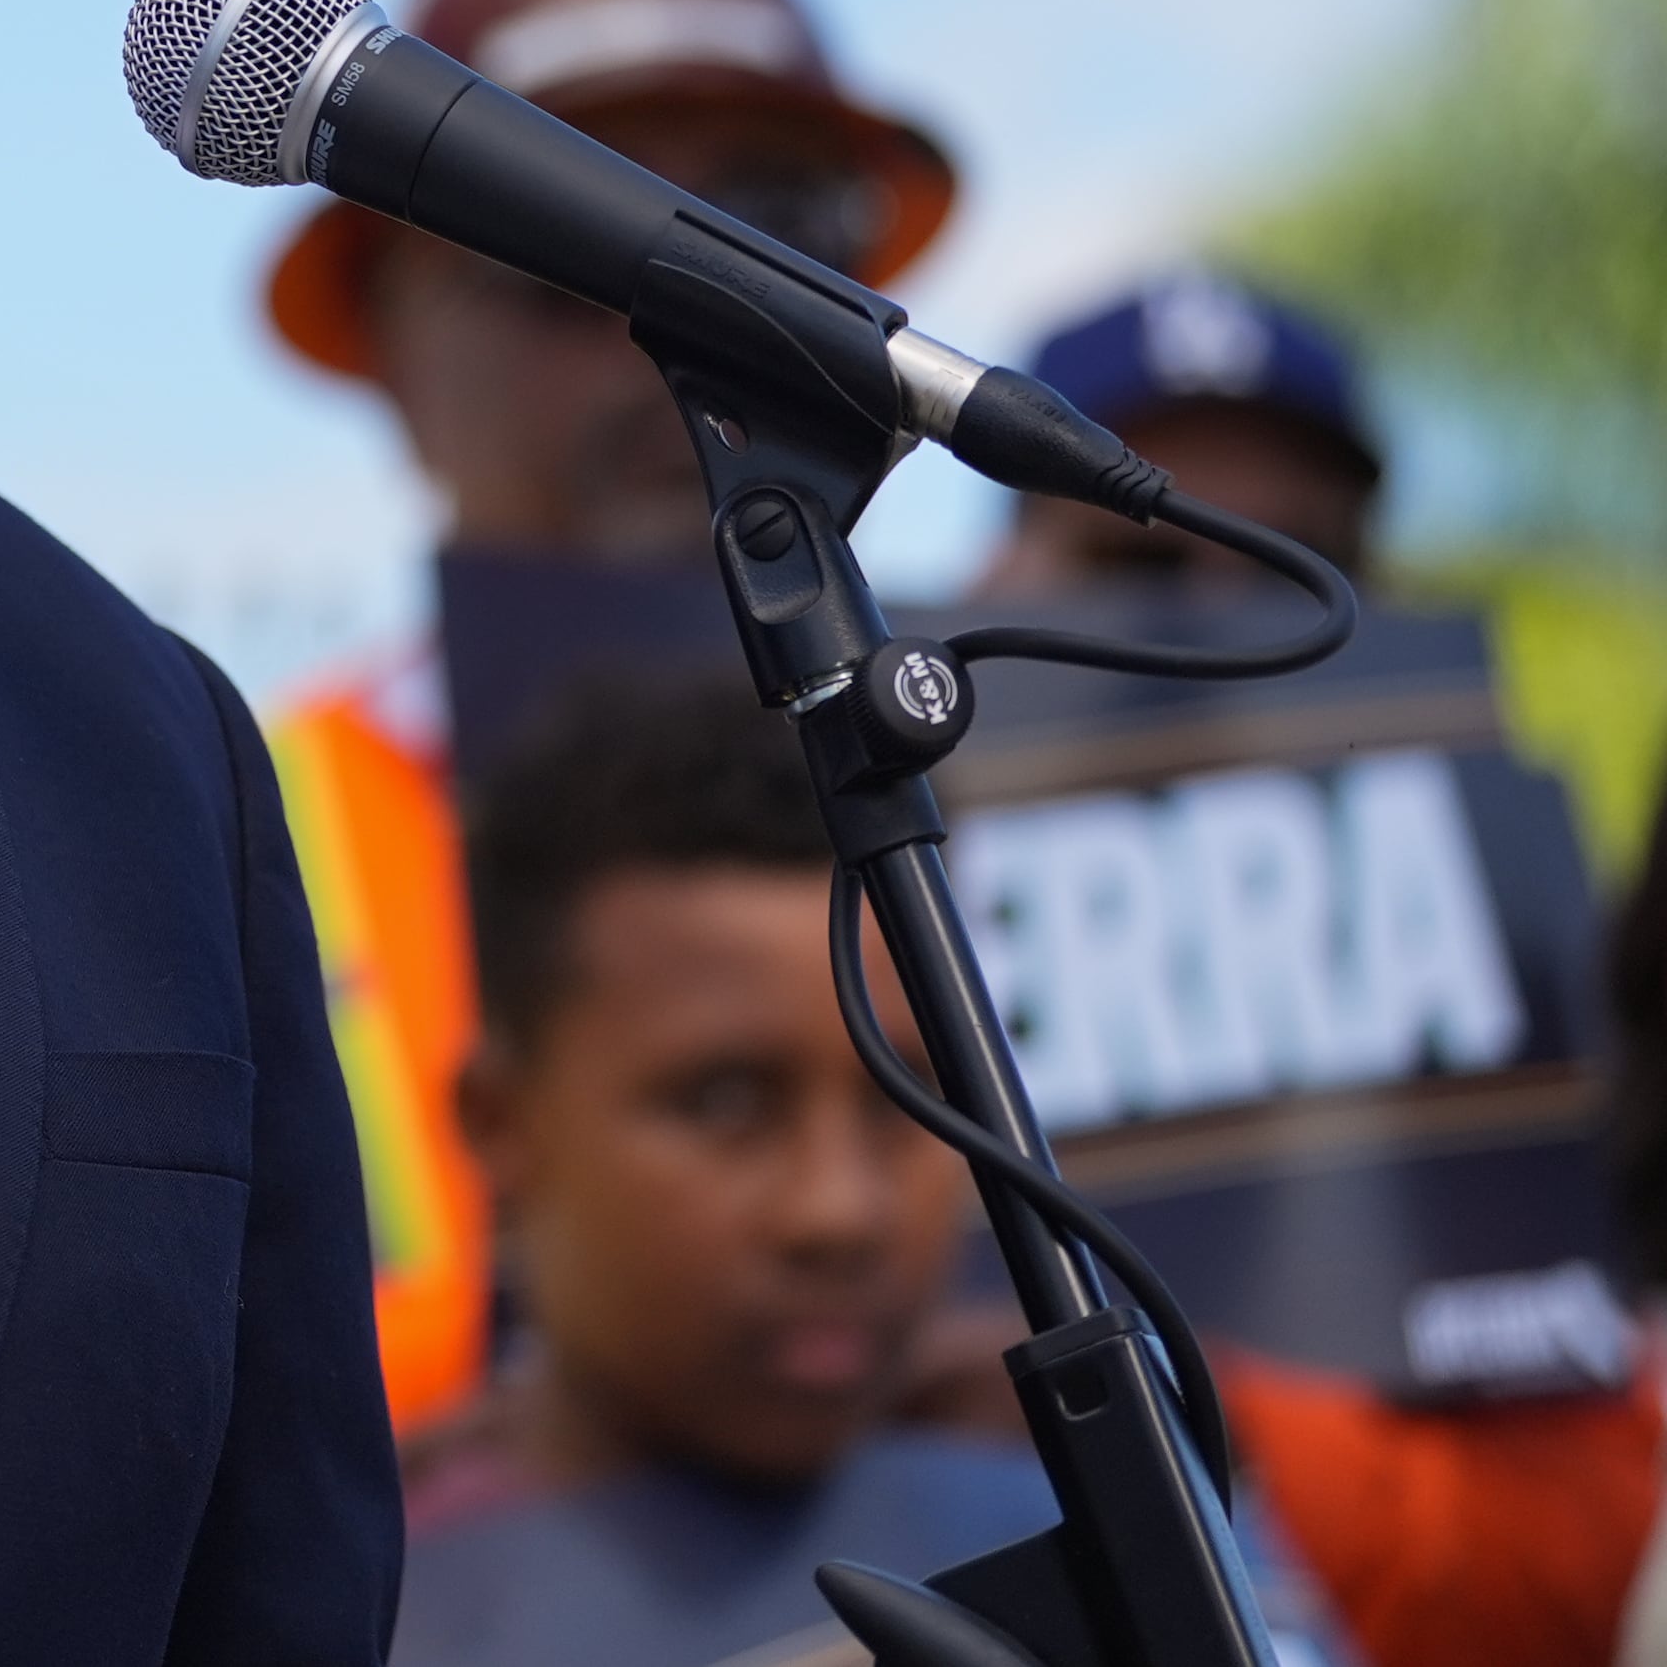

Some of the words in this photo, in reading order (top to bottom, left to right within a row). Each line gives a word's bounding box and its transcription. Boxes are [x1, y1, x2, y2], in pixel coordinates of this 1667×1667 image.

[331, 61, 365, 107] SM58
[903, 651, 948, 725] K&M
[951, 745, 1529, 1135] ERRA
